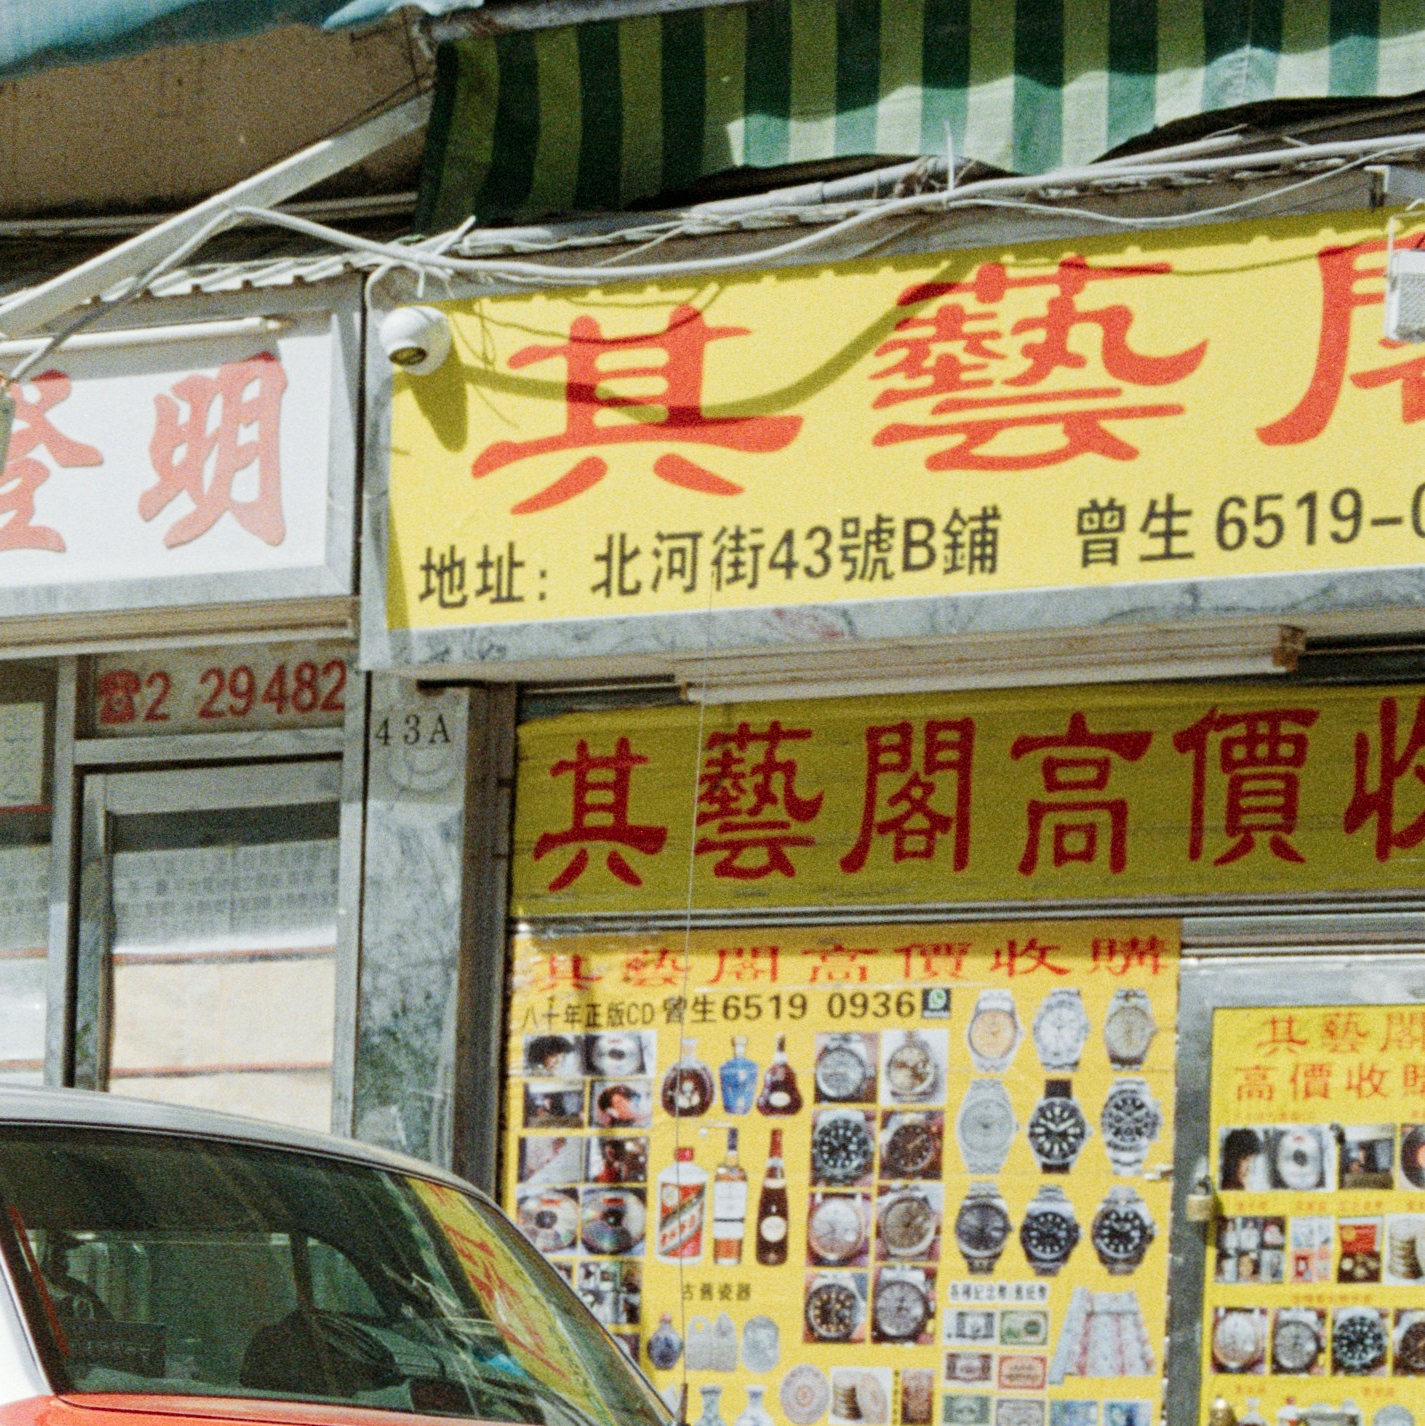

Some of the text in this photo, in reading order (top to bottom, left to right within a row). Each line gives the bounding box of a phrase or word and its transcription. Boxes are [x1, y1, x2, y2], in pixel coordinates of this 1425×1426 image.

[1076, 493, 1196, 569] 曾生
[375, 713, 451, 746] 43A
[826, 992, 916, 1019] 0936
